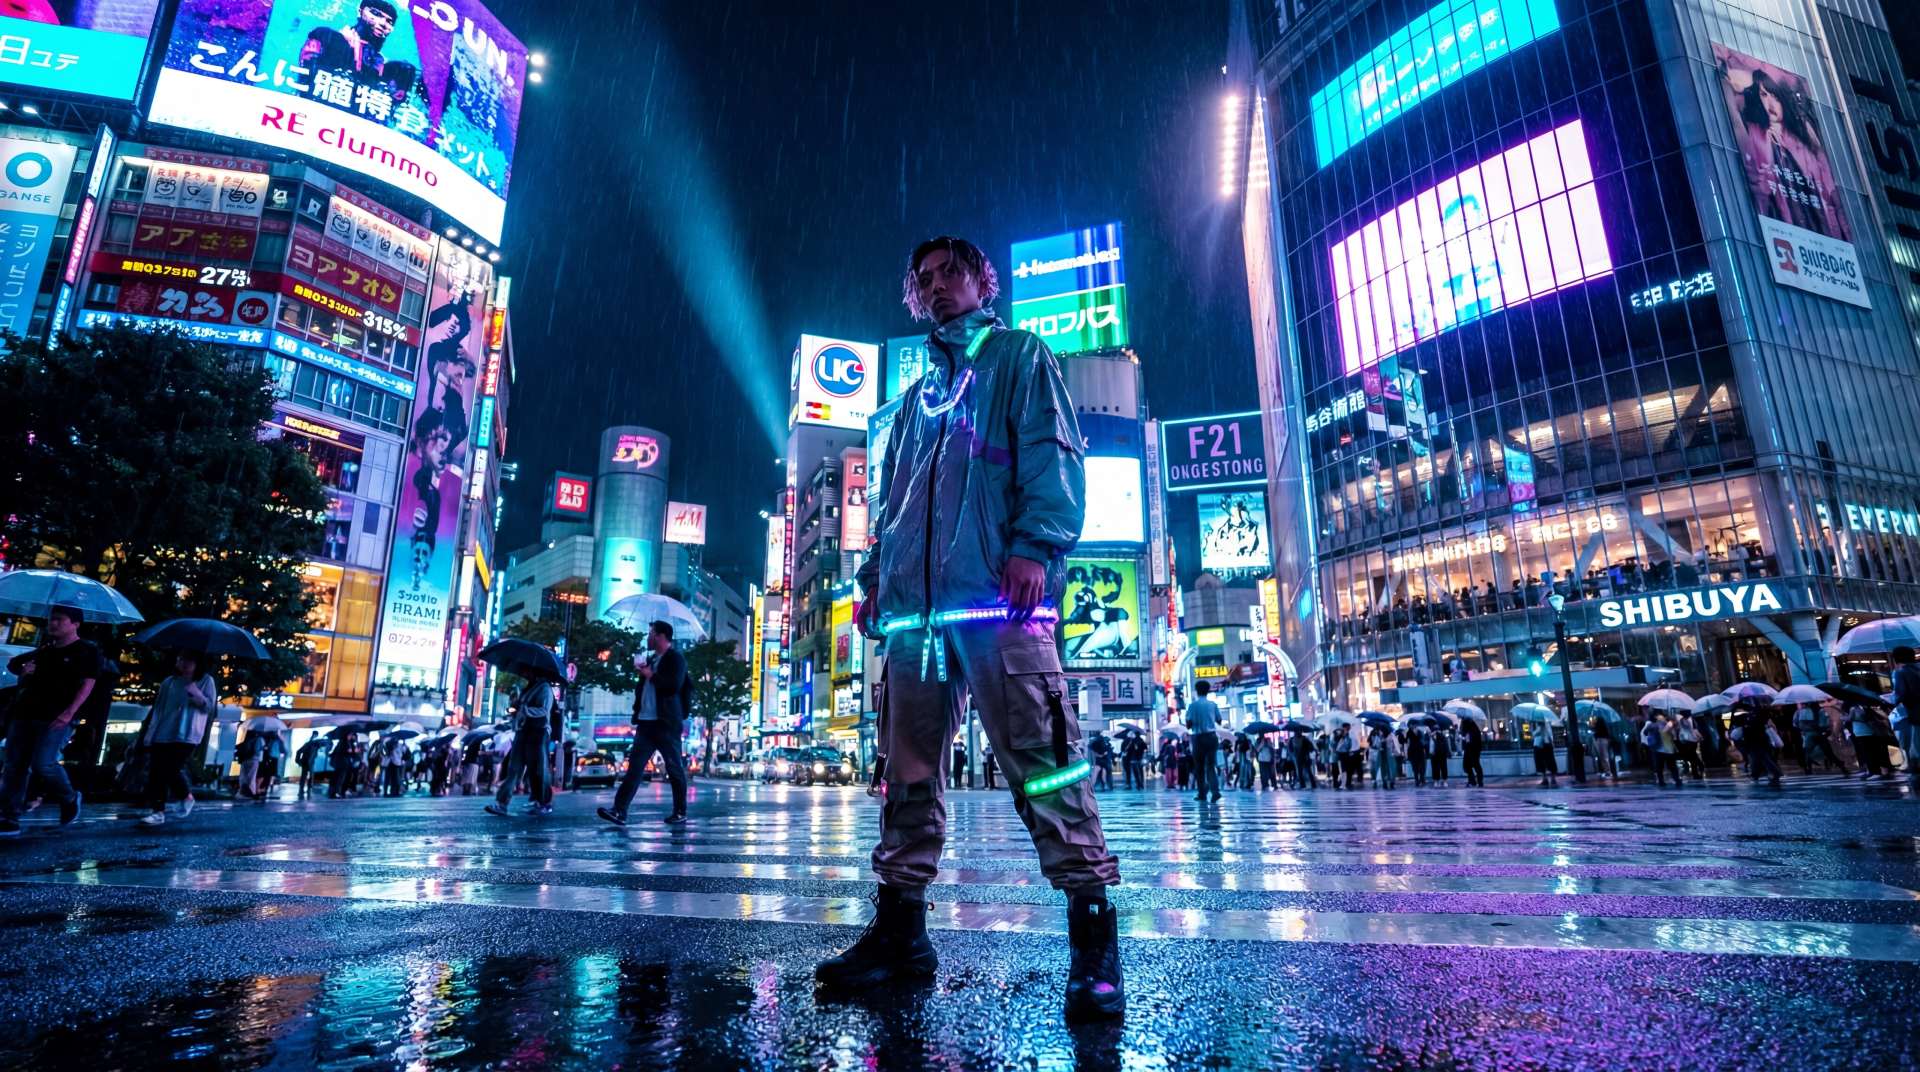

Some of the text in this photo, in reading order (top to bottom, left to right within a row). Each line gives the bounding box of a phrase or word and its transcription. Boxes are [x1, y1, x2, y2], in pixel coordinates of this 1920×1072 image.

[318, 126, 438, 187] clummo
[1188, 422, 1242, 460] F21
[1600, 583, 1782, 627] SHIBUYA
